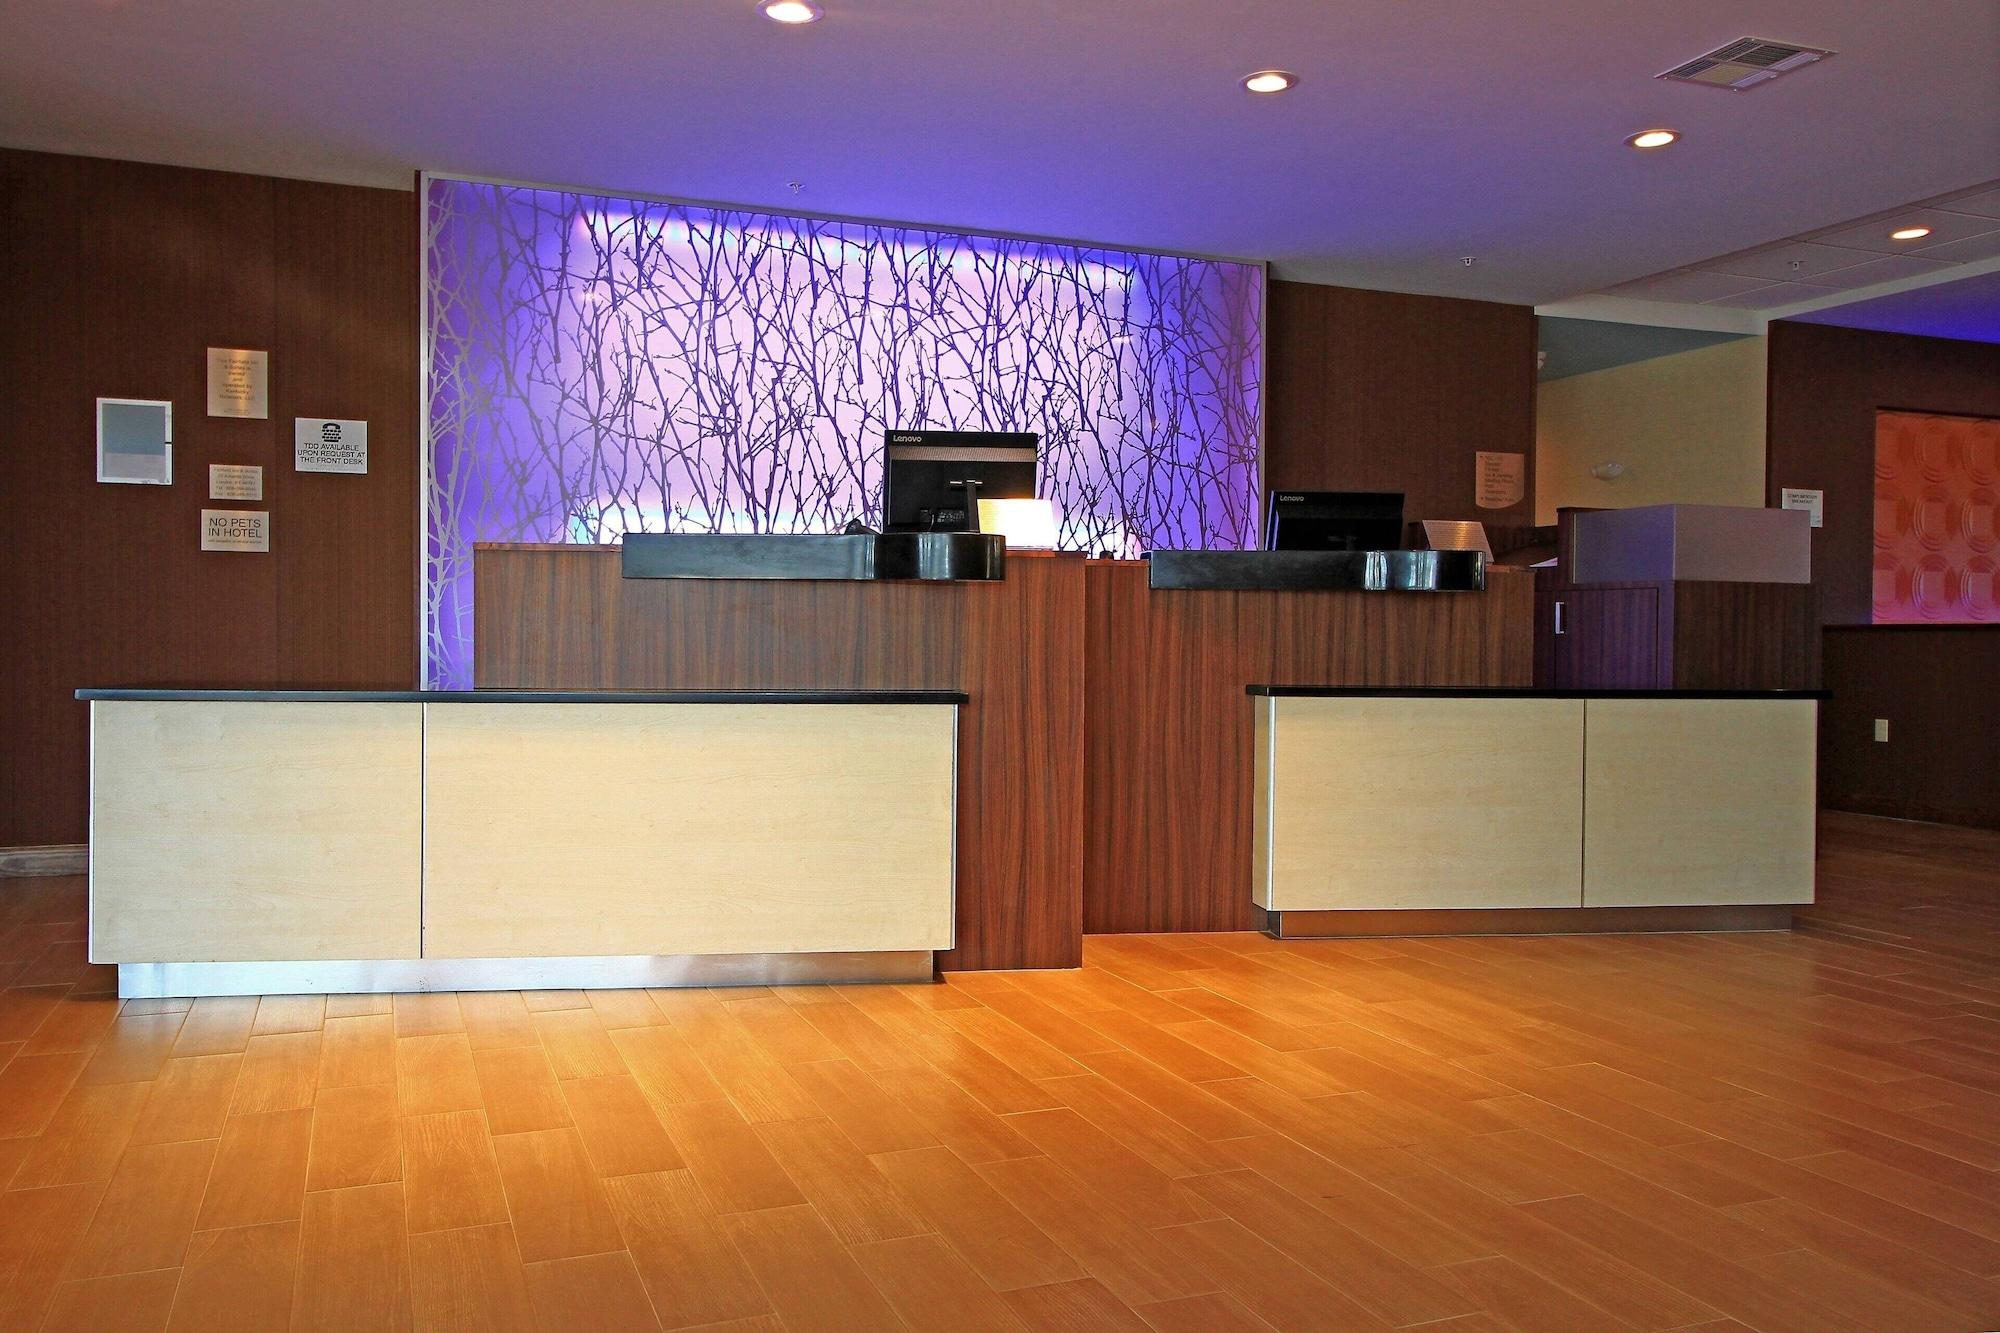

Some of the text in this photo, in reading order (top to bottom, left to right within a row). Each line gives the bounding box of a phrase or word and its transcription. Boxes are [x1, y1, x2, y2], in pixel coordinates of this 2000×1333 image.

[893, 434, 922, 443] Lenovo
[209, 517, 261, 528] NO PETS
[208, 527, 262, 539] IN HOTEL
